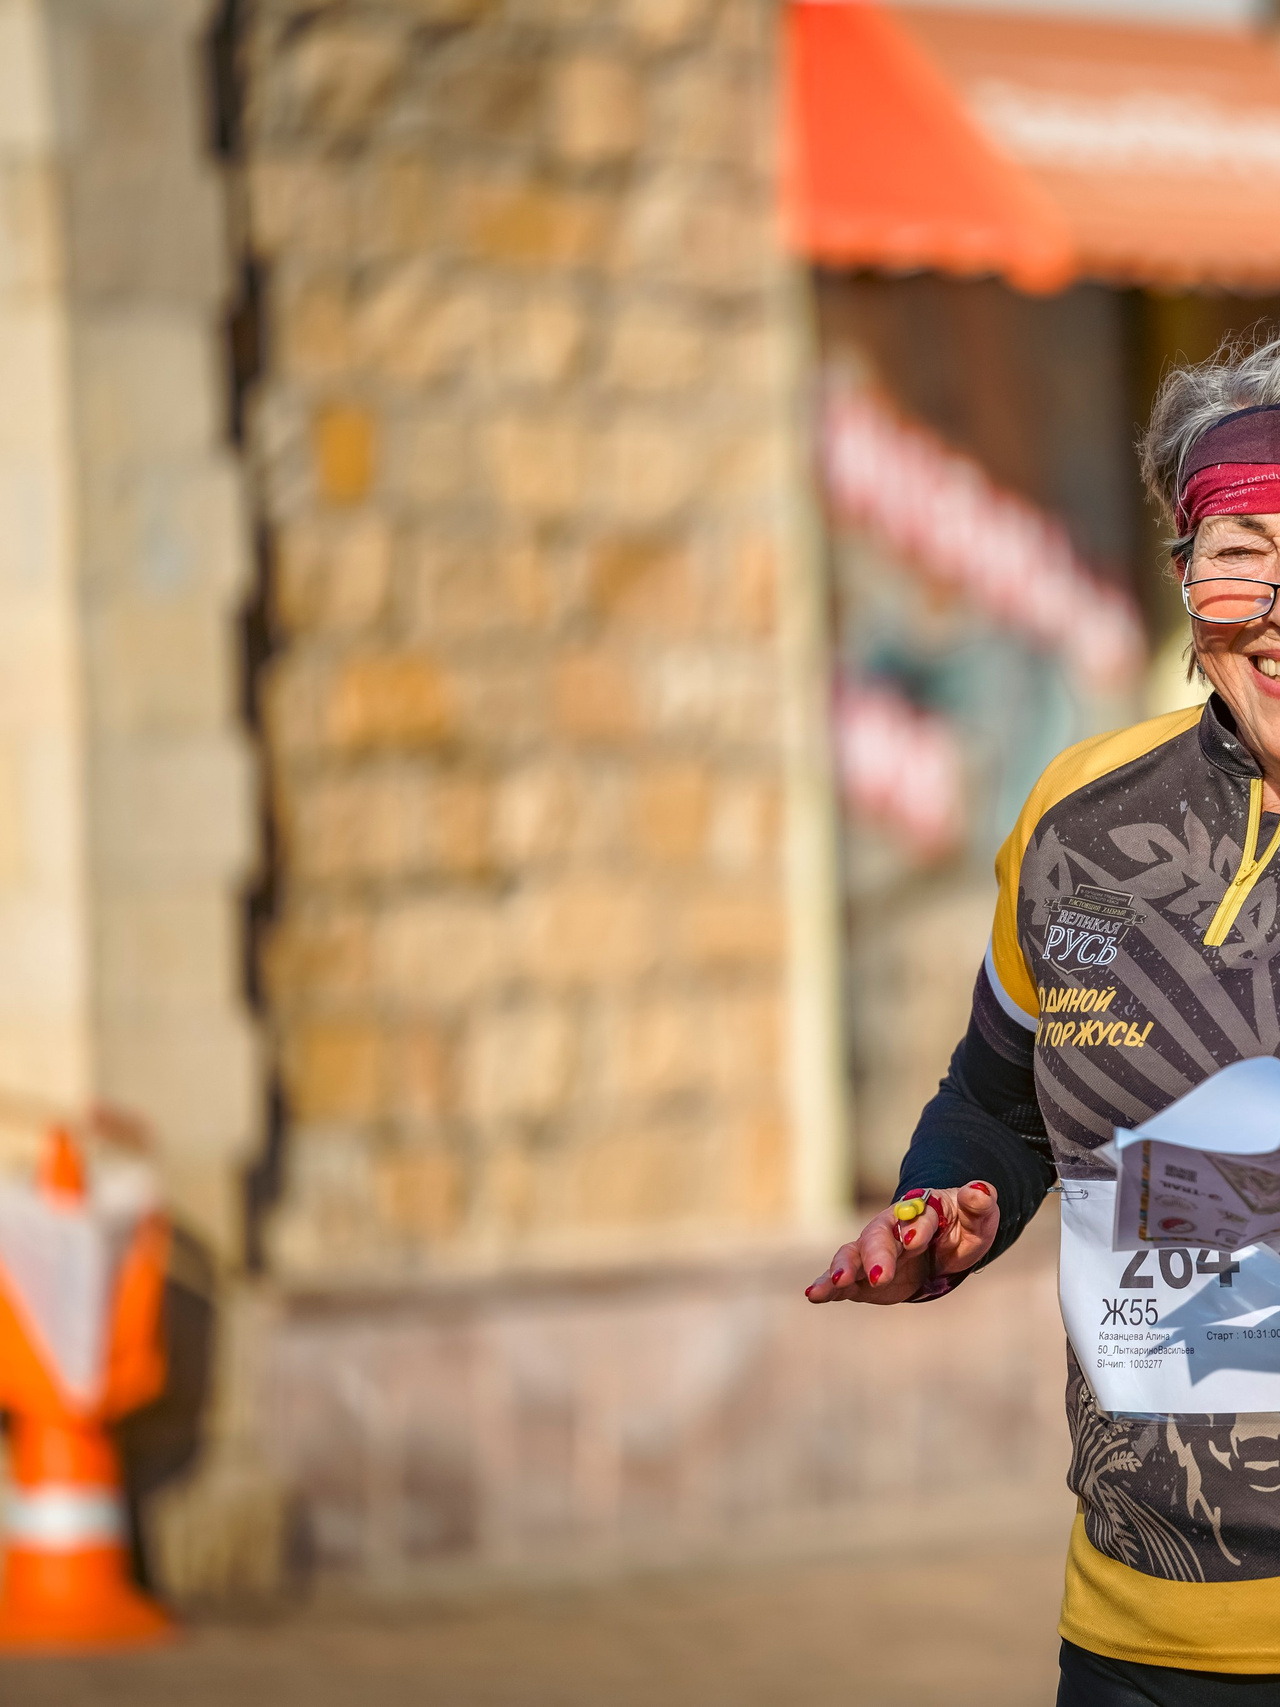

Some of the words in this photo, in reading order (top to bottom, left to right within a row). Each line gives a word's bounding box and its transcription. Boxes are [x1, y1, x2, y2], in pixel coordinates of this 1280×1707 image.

[1056, 909, 1123, 935] ВЕЛИКАЯ
[1042, 925, 1118, 966] РУСЬ
[1037, 986, 1117, 1013] ОДИНОЙ
[1044, 1019, 1155, 1048] ГОРЖУСЬ!
[1100, 1298, 1159, 1326] Ж55
[1098, 1331, 1144, 1342] Казанцева
[1145, 1331, 1170, 1341] Алина
[1206, 1331, 1234, 1343] Старт
[1097, 1345, 1195, 1357] 50_ЛыткариноВасильев
[1096, 1359, 1126, 1370] SI-чип:
[1129, 1359, 1163, 1370] 1003277
